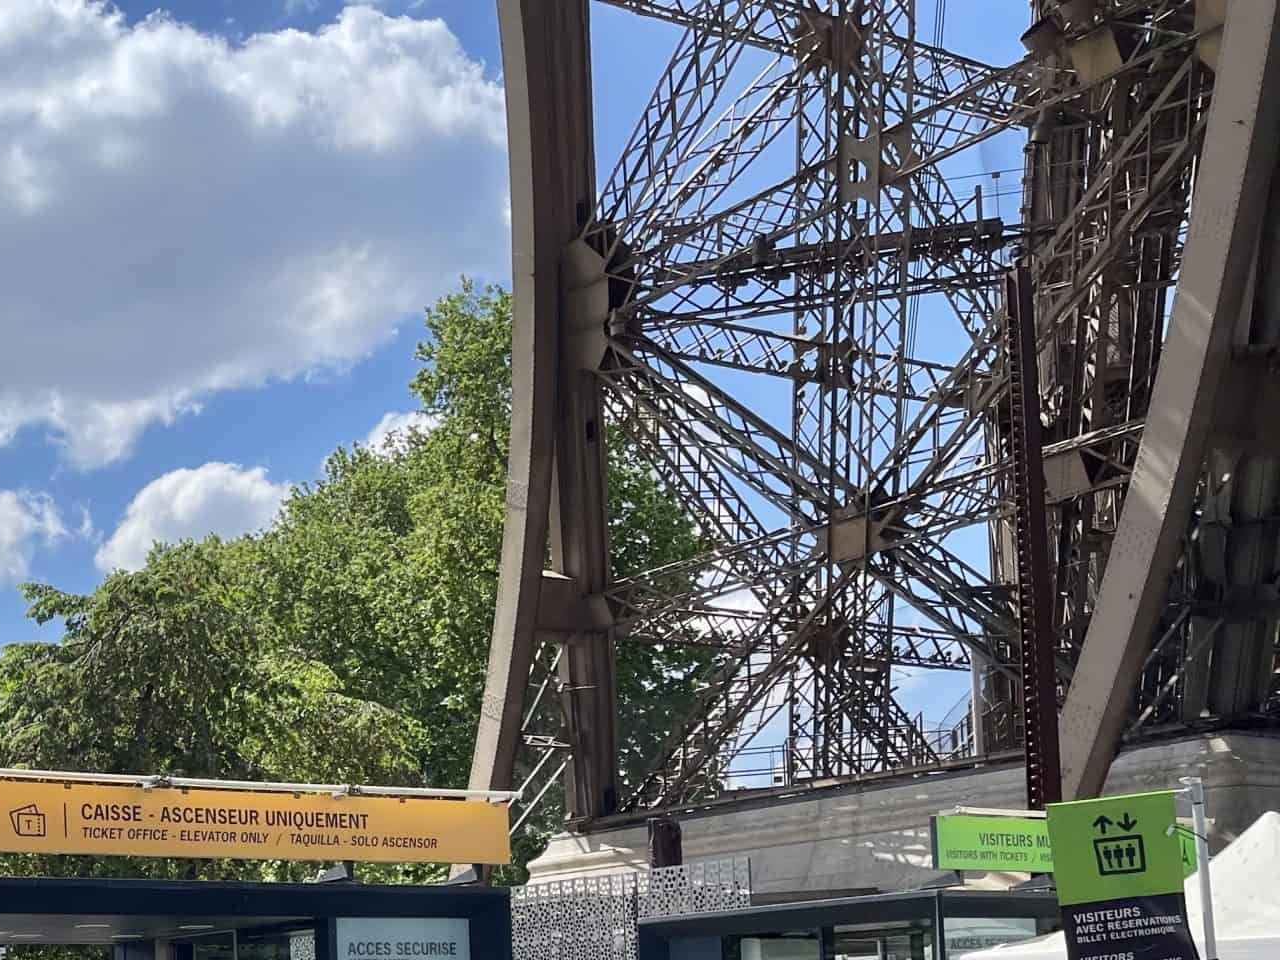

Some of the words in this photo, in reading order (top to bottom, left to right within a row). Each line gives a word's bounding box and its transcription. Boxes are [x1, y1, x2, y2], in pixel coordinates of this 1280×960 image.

[81, 803, 143, 822] CAISSE
[160, 806, 259, 826] ASCENSEUR
[265, 810, 369, 830] UNIQUEMENT
[82, 826, 124, 840] TICKET
[127, 828, 168, 841] OFFICE
[180, 829, 237, 843] ELEVATOR
[241, 831, 269, 844] ONLY
[290, 833, 340, 847] TAQUILLA
[351, 835, 378, 847] SOLO
[382, 836, 438, 849] ASCENSOR
[979, 832, 1033, 847] VISITEURS
[946, 848, 978, 860] VISITORS
[980, 850, 998, 861] WITH
[1000, 851, 1028, 862] TICKETS
[1073, 907, 1141, 924] VISITEURS
[1076, 923, 1104, 935] AVEC
[1107, 914, 1182, 933] RESERVATIONS
[1077, 934, 1107, 944] BILLET
[347, 942, 391, 956] ACCES
[396, 942, 457, 956] SECURISE
